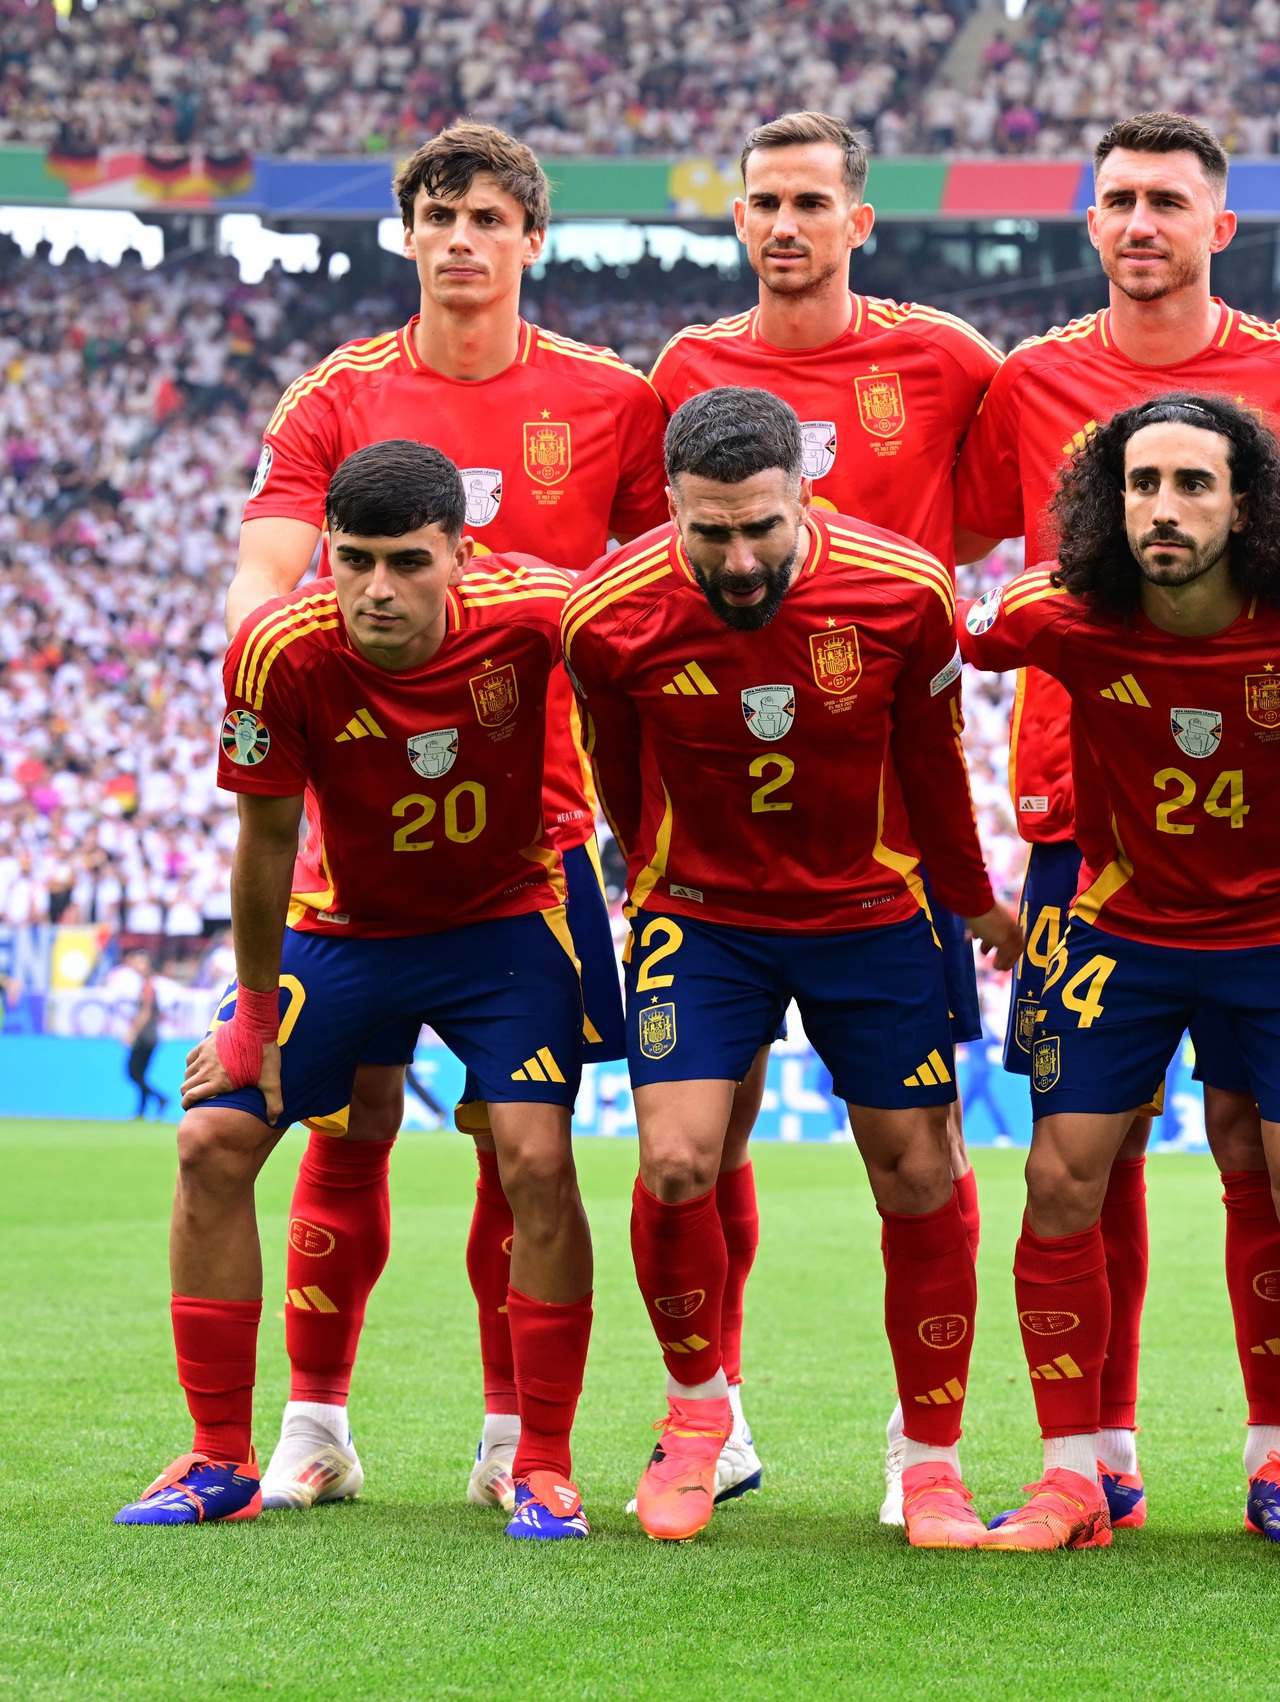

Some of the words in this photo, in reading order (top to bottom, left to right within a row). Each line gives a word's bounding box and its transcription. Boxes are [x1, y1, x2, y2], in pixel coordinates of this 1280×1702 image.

[392, 781, 486, 852] 20
[749, 753, 795, 813] 2
[1153, 767, 1250, 835] 24
[636, 917, 684, 993] 2
